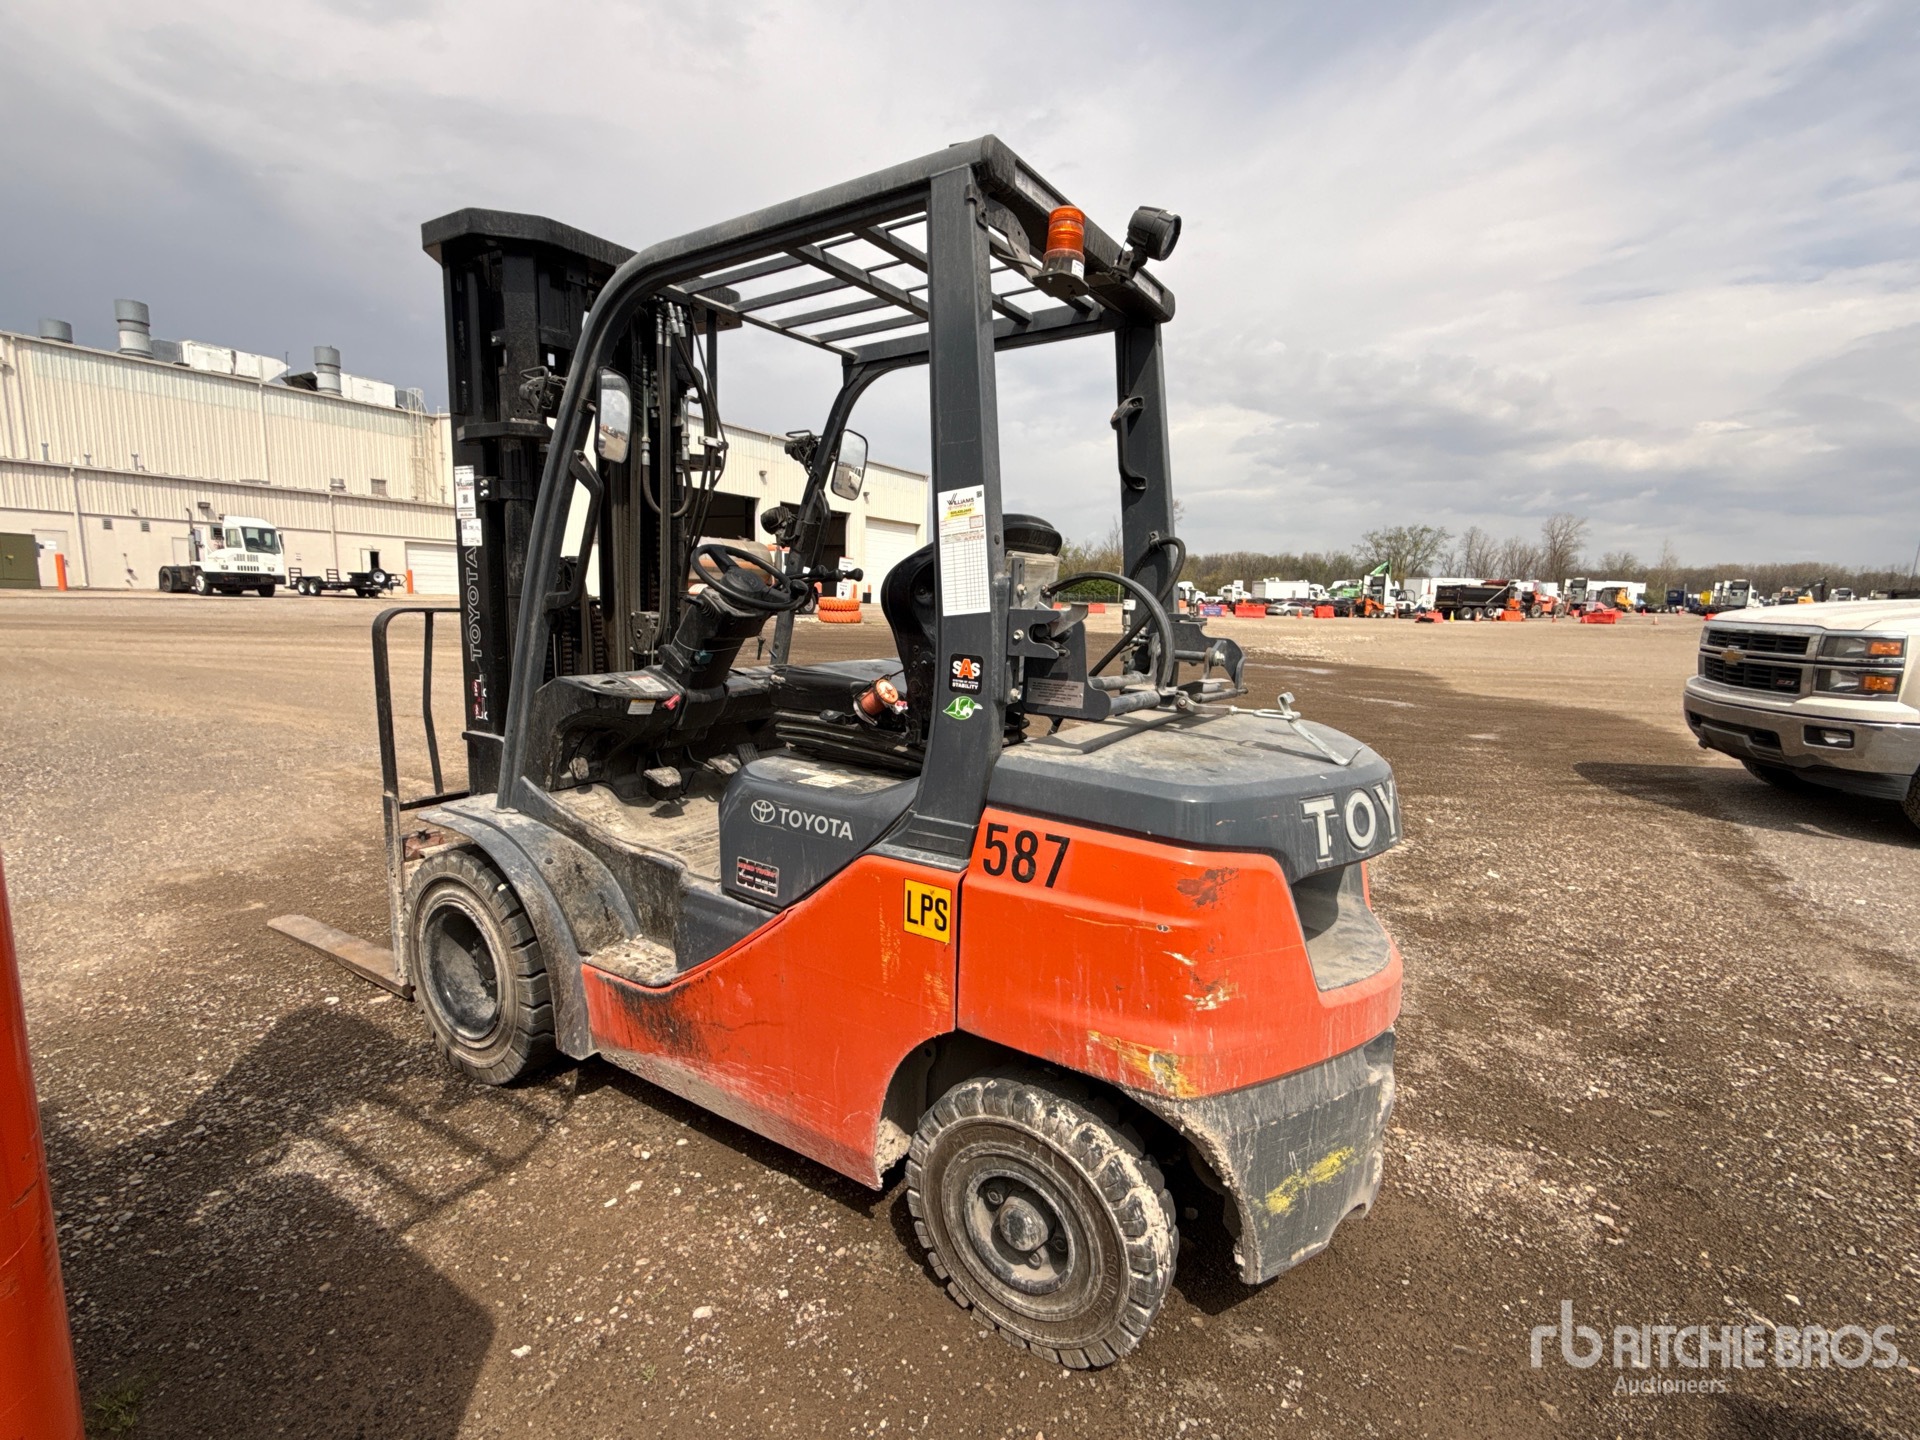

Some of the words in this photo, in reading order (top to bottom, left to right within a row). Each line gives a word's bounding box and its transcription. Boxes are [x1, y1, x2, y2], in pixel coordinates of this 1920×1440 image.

[466, 547, 482, 661] TOYOTA
[952, 658, 981, 679] SAS
[779, 807, 854, 842] TOYOTA
[983, 823, 1071, 888] 587
[906, 889, 948, 932] LPS
